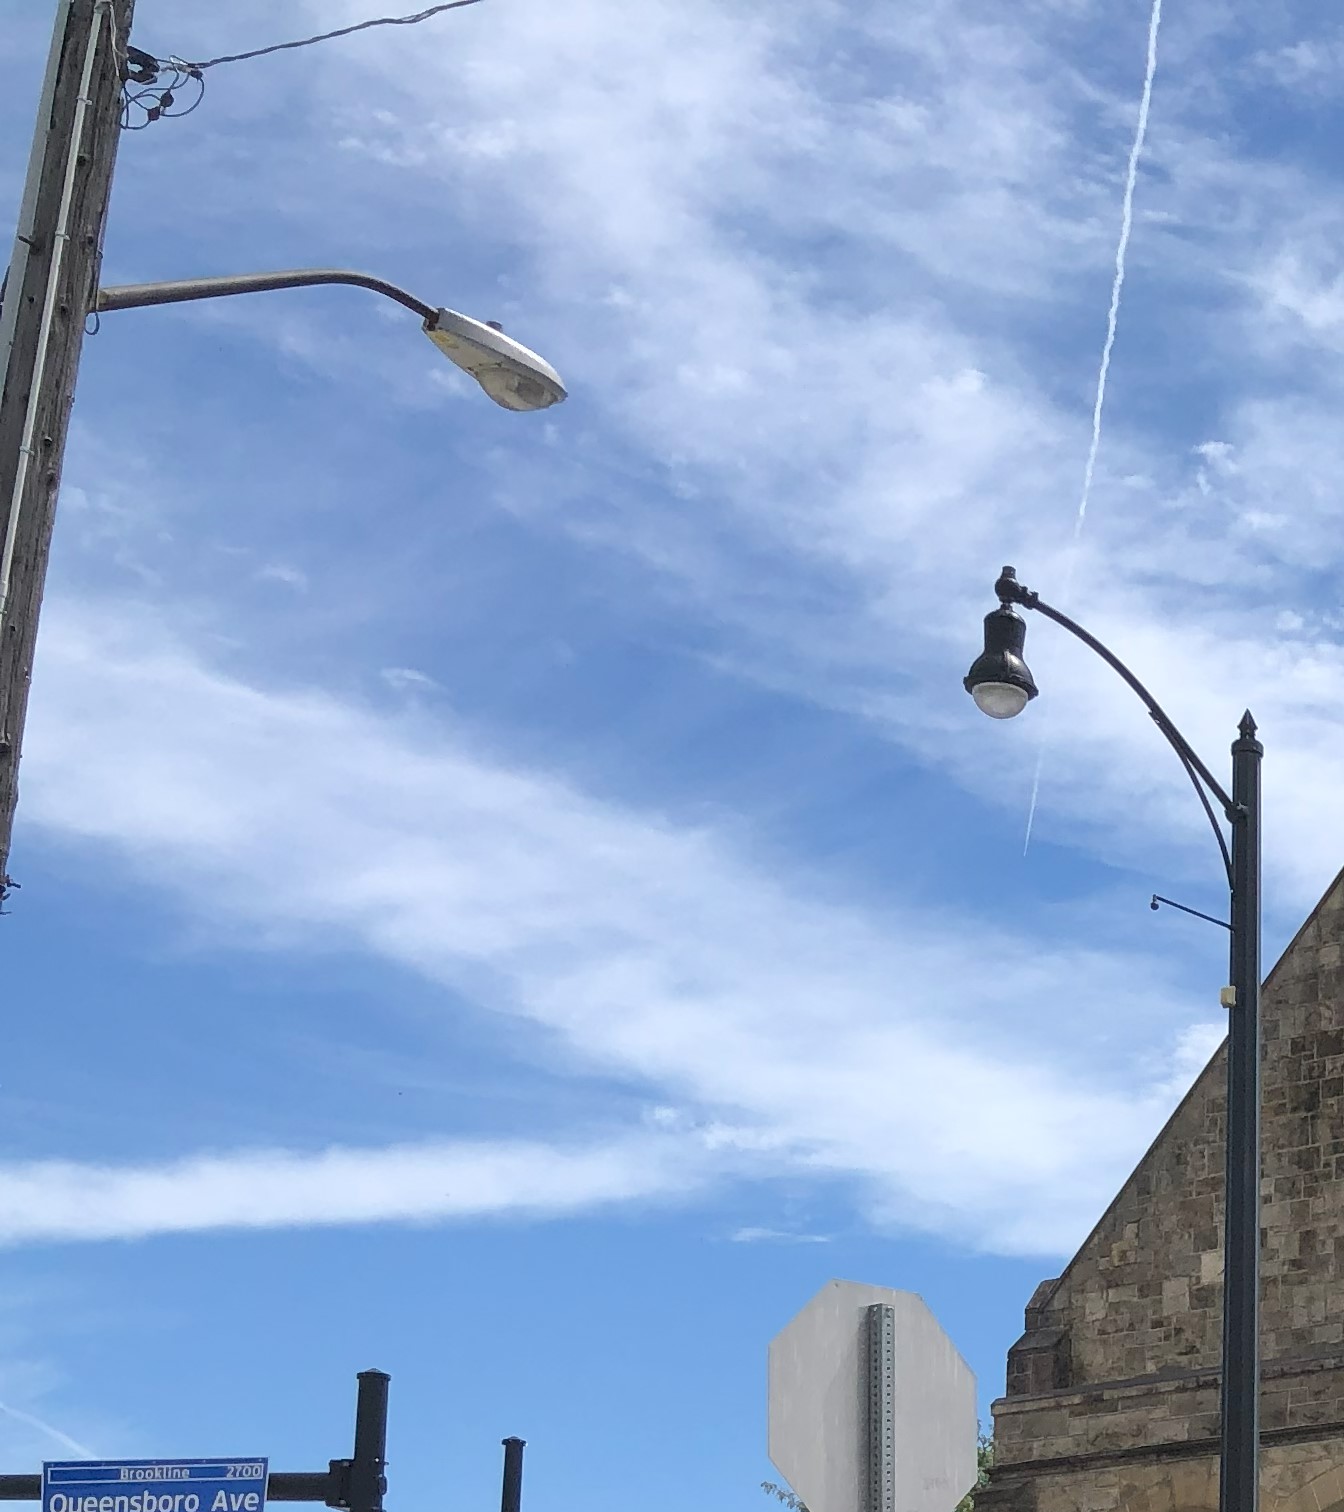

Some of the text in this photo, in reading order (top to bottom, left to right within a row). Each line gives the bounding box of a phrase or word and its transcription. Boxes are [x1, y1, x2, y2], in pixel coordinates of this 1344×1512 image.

[120, 1464, 262, 1480] Brookline 2700
[211, 1490, 259, 1512] Ave
